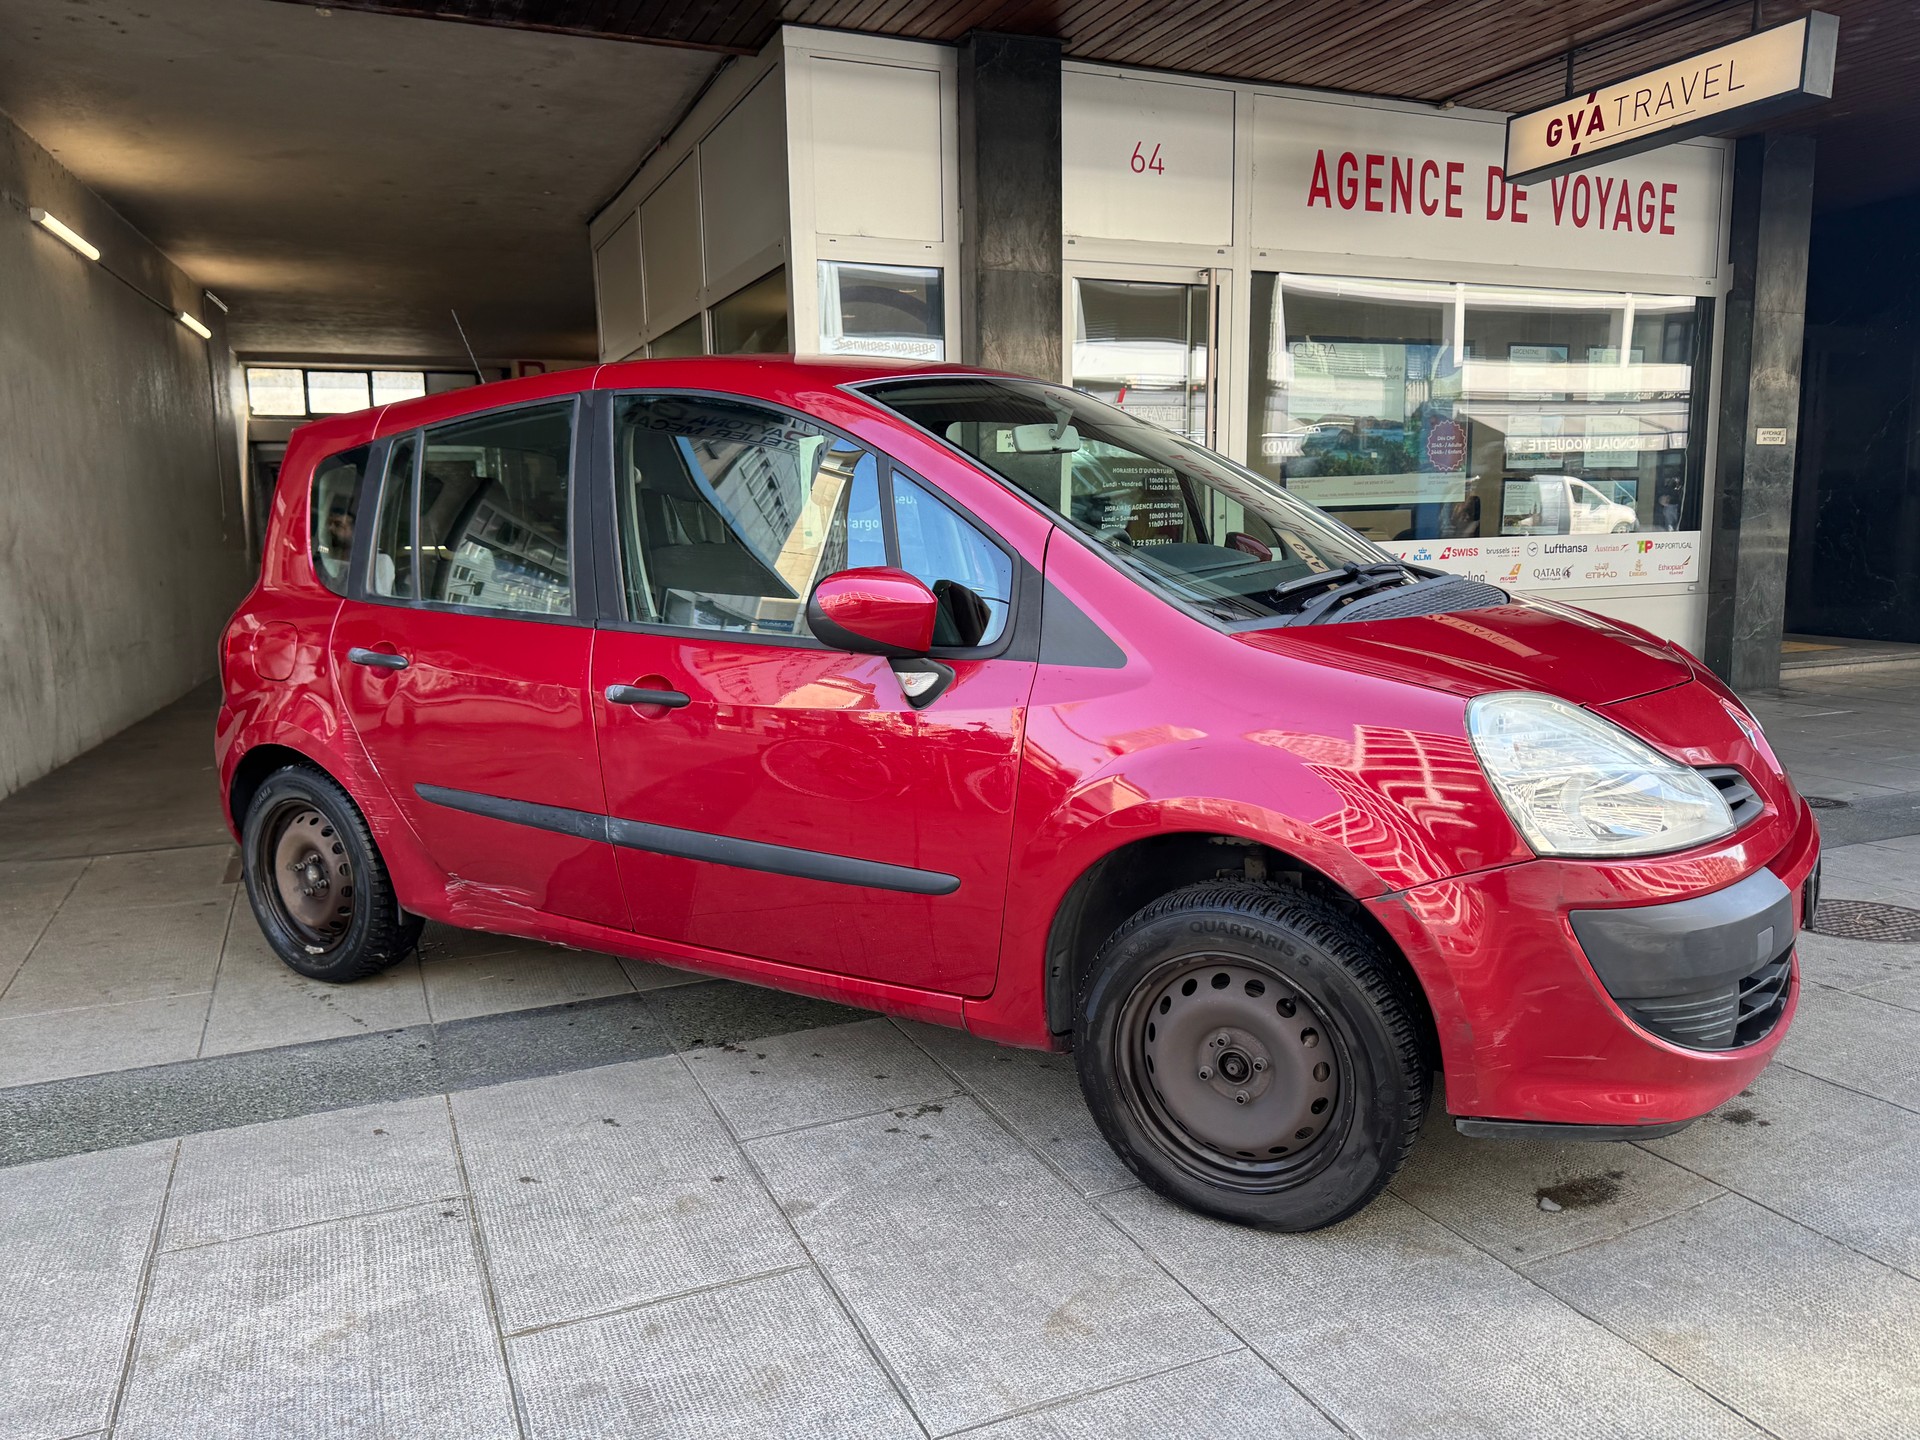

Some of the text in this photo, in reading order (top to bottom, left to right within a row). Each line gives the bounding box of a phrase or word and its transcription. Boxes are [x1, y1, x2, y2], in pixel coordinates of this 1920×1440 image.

[1546, 60, 1745, 150] GVA TRAVEL
[1131, 141, 1165, 175] 64
[1307, 149, 1678, 235] AGENCE DE VOYAGE
[1452, 548, 1479, 557] SWISS
[1544, 543, 1588, 554] Lufthansa
[1533, 567, 1561, 579] QATAR
[1585, 571, 1618, 579] ETIHAD
[1189, 920, 1298, 957] QUARTARIS
